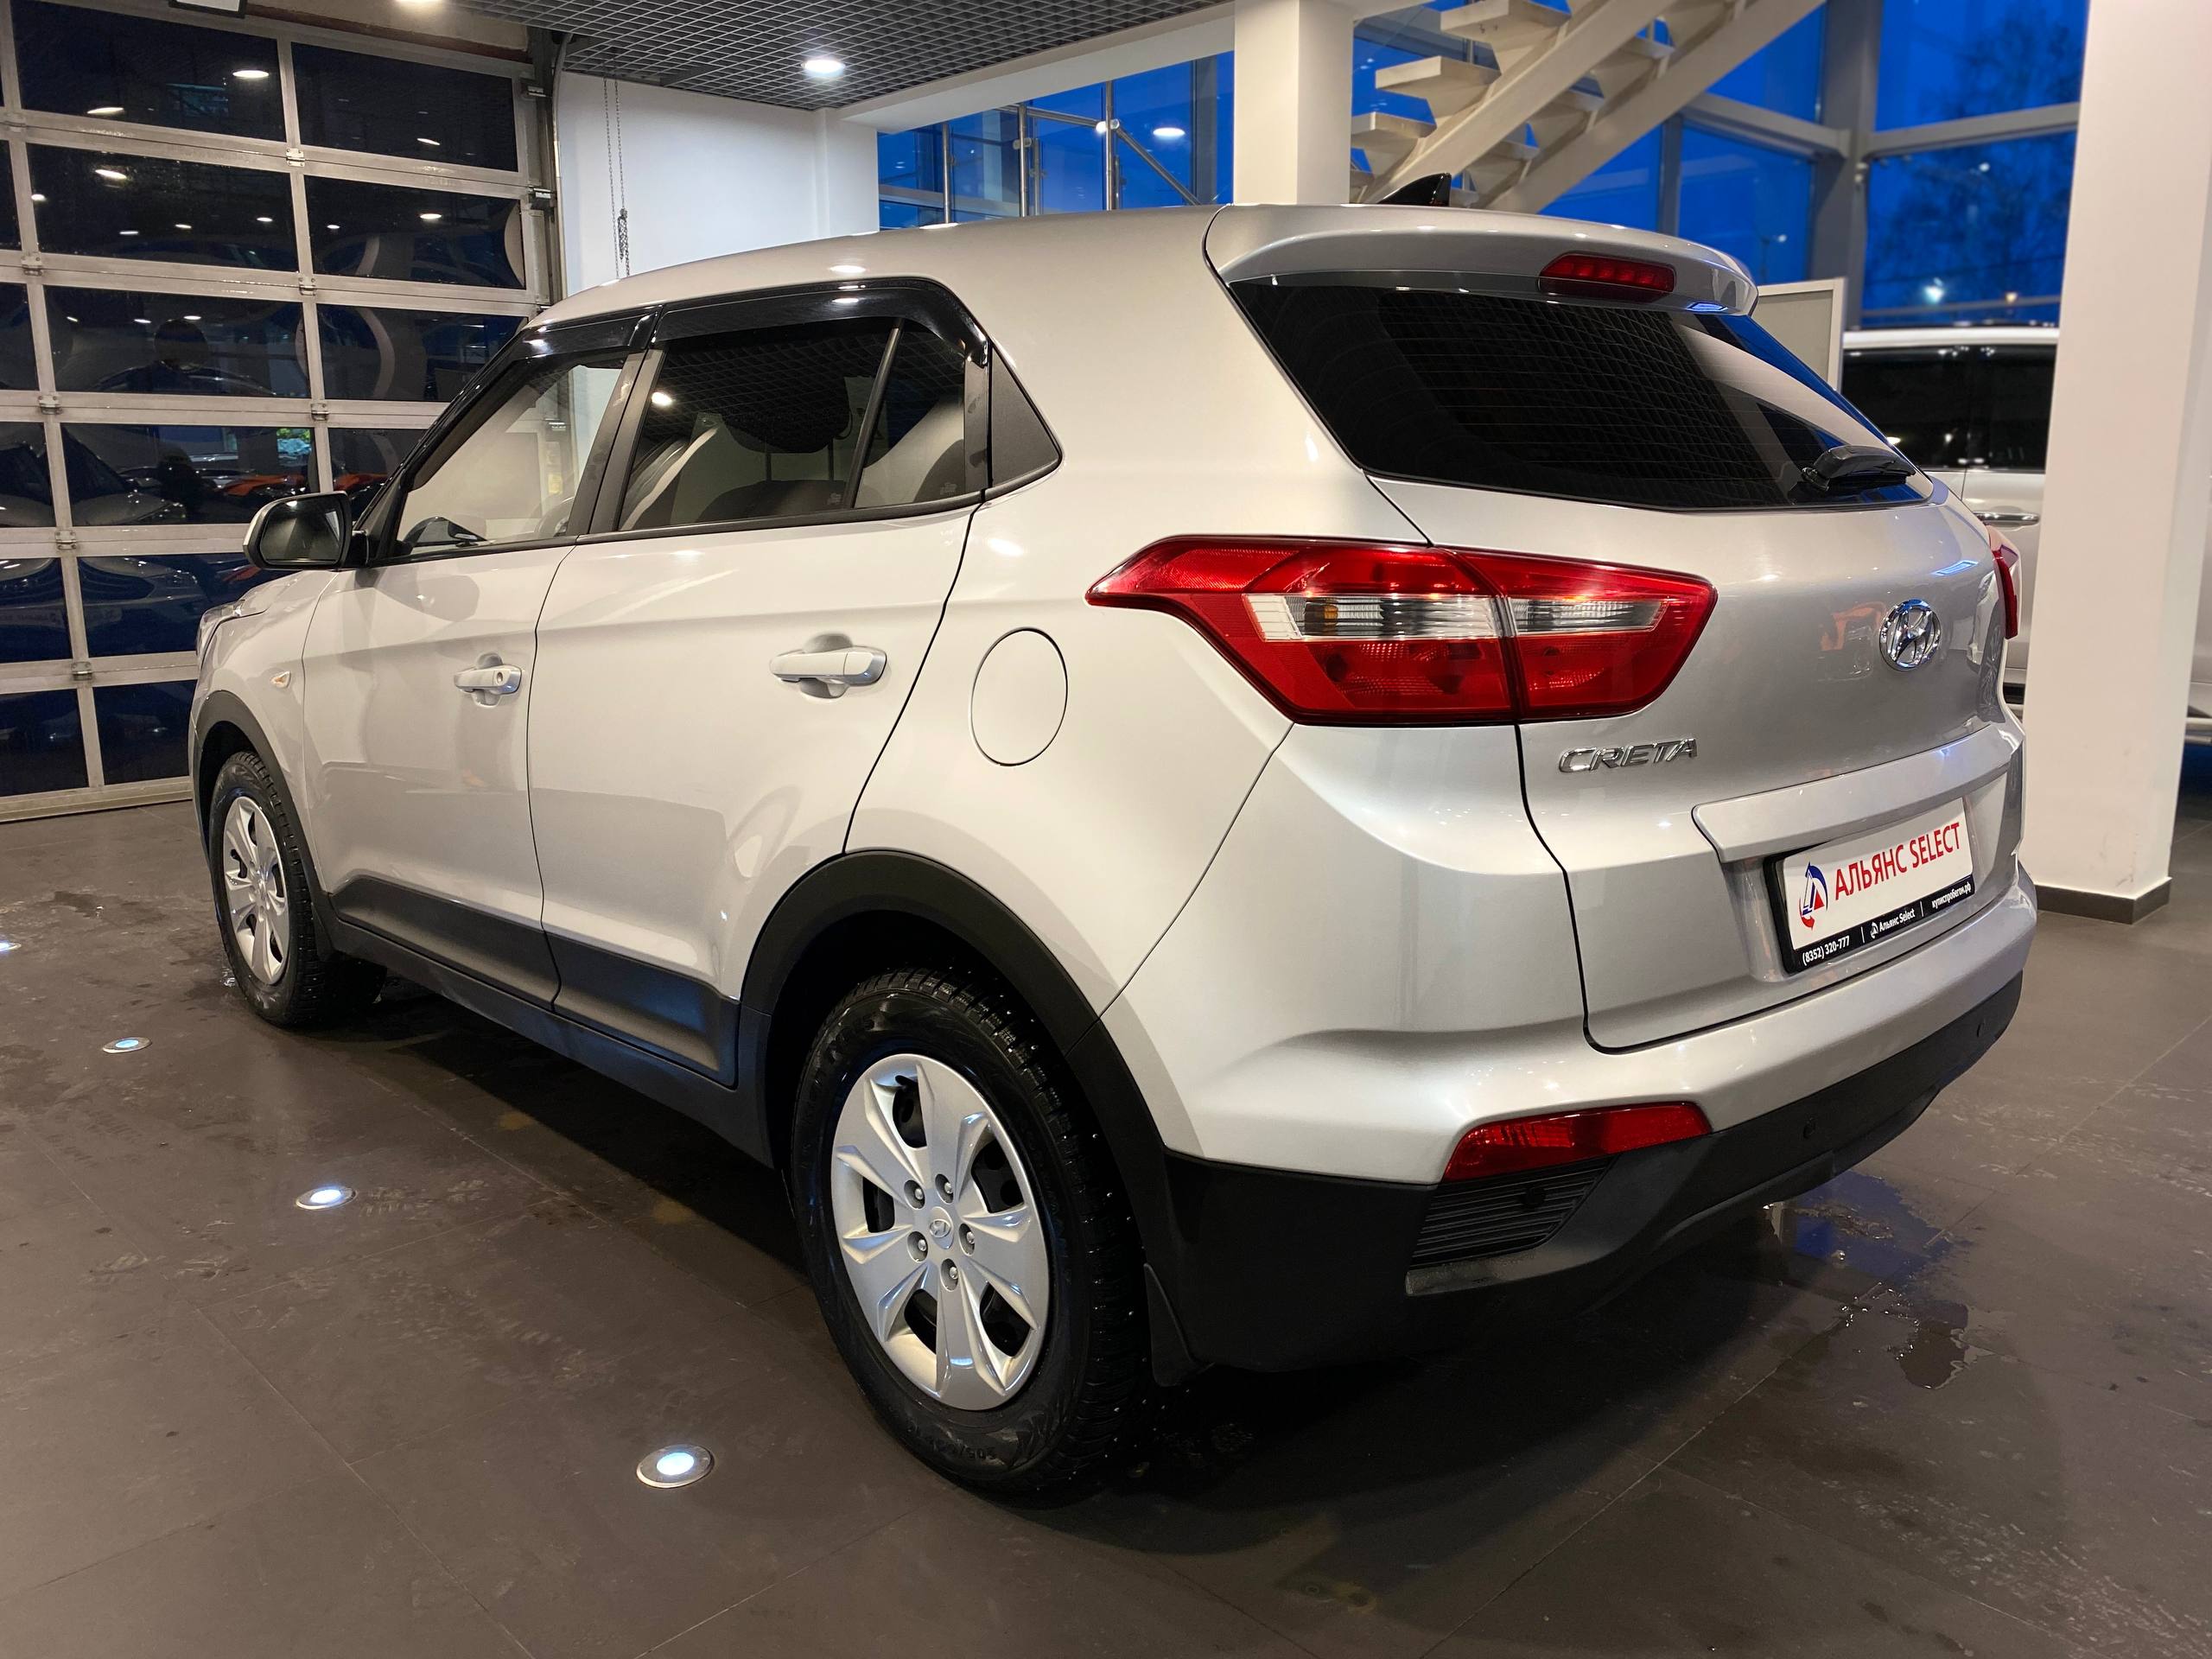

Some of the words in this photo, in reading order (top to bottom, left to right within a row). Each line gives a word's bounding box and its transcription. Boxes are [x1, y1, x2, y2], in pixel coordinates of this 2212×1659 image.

[1559, 738, 1698, 772] CRETA
[1834, 844, 1908, 900] АЛЬЯНС
[1909, 822, 1960, 868] SELECT
[1879, 918, 1900, 932] Альянс
[1898, 909, 1916, 923] Select
[1802, 944, 1825, 966] (8352)
[1824, 936, 1850, 956] 320-777
